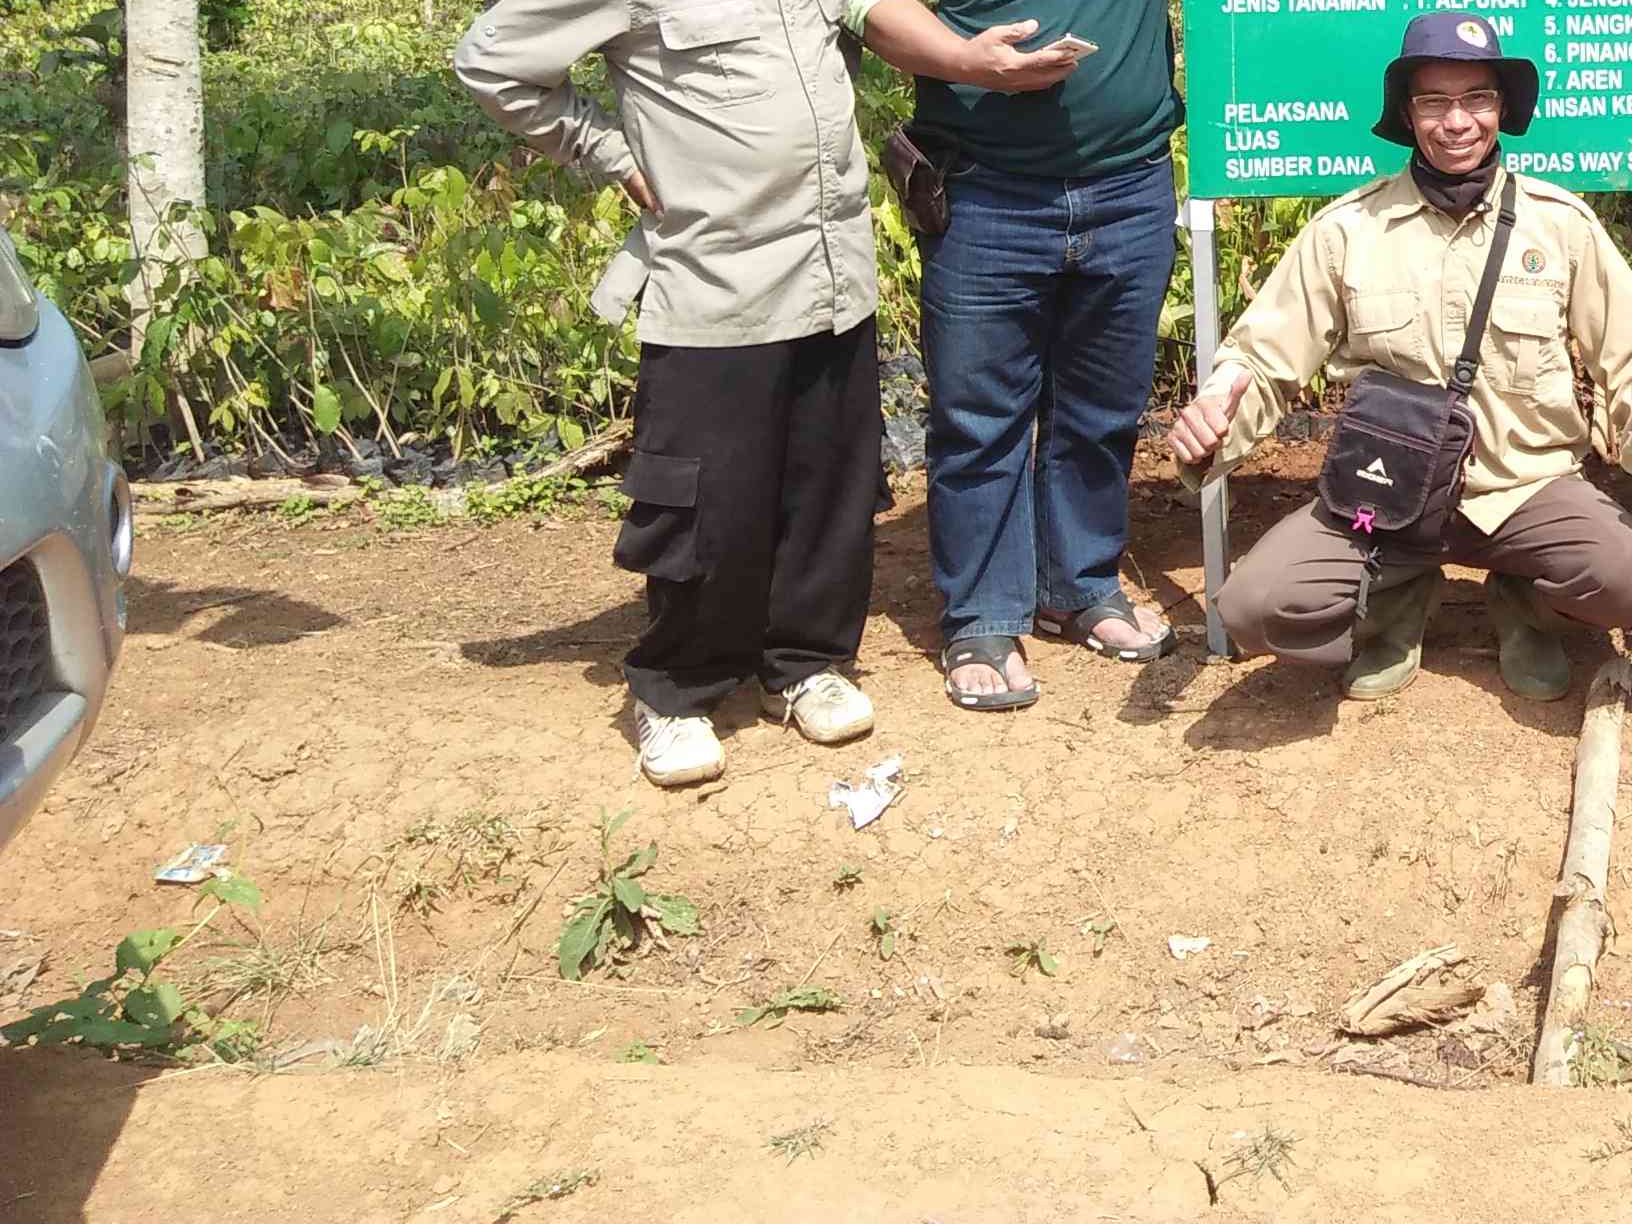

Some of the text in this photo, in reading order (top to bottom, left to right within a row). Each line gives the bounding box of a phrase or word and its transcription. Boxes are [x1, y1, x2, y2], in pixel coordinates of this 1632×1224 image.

[1544, 15, 1561, 36] 5.
[1544, 42, 1562, 64] 6.
[1545, 69, 1623, 90] 7. AREN
[1224, 101, 1349, 123] PELAKSANA
[1545, 96, 1607, 118] INSAN
[1225, 128, 1281, 152] LUAS
[1225, 156, 1313, 179] SUMBER
[1317, 155, 1376, 176] DANA
[1505, 152, 1575, 173] BPDAS
[1579, 151, 1624, 172] WAY
